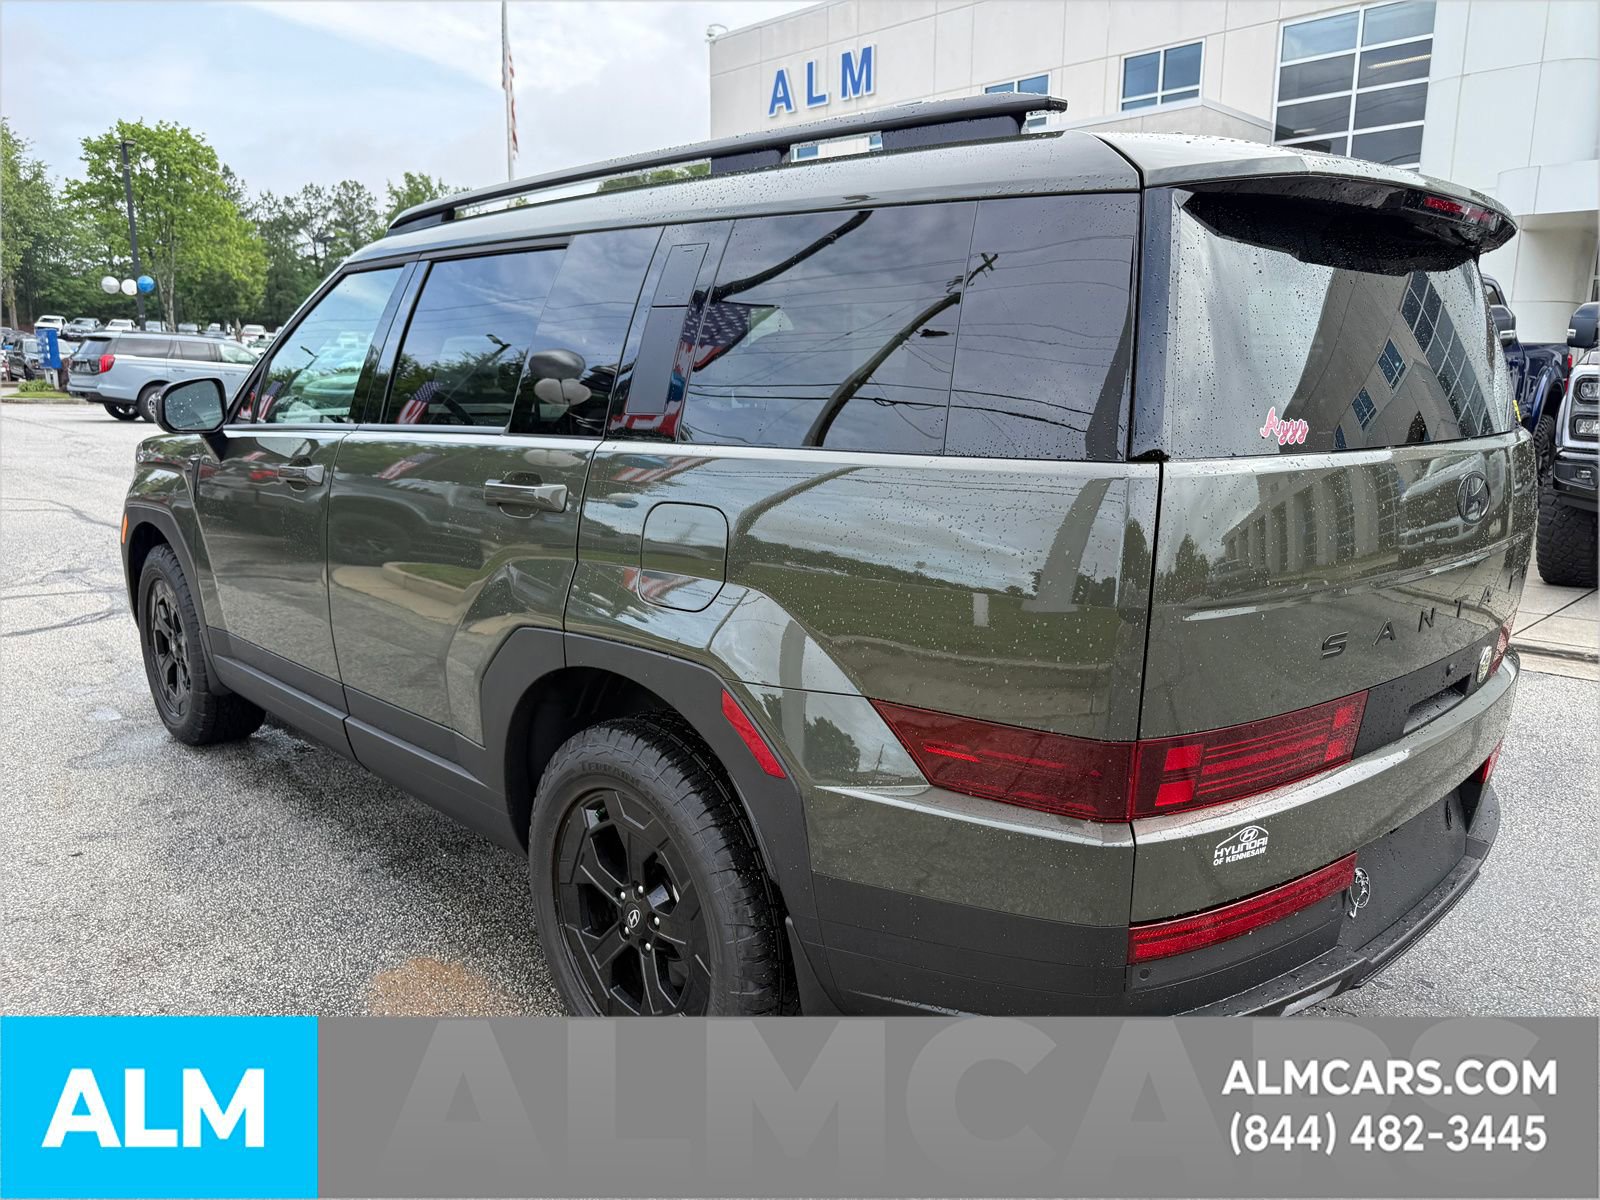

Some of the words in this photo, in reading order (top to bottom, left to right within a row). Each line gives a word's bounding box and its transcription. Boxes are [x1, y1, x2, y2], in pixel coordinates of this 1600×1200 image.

[767, 46, 874, 116] ALM
[1320, 584, 1493, 660] SANTA
[1213, 858, 1224, 866] OF
[1225, 846, 1267, 863] KENNESAW
[1214, 837, 1268, 858] HYUNDAI
